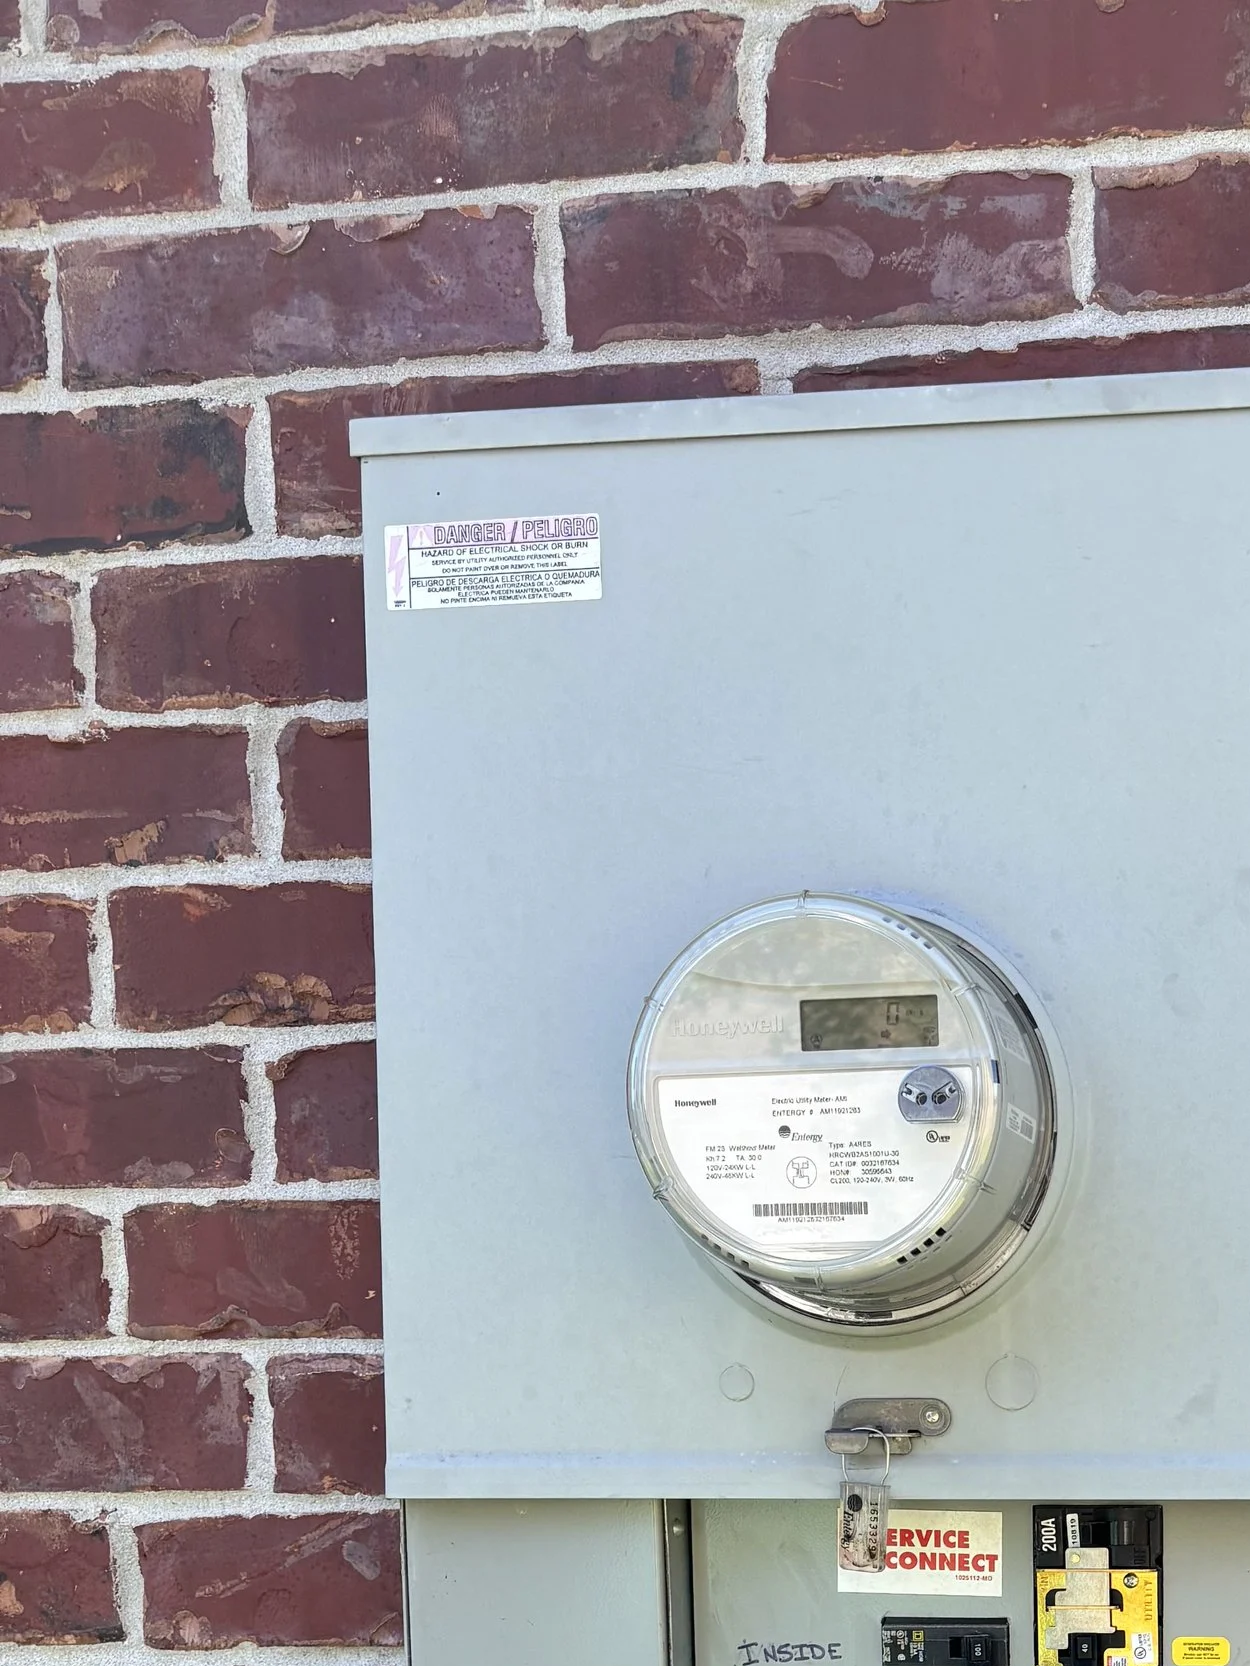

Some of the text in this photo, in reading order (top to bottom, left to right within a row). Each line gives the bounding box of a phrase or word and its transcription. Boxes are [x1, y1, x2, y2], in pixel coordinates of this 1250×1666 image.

[433, 522, 506, 545] DANGER
[522, 516, 598, 539] PELIGRO
[421, 541, 588, 557] HAZARD OF ELECTRICAL SHOCK OR BURN
[411, 579, 445, 588] PELIGRO
[446, 578, 457, 586] DE
[458, 576, 499, 585] DESCARGA
[501, 573, 542, 582] ELECTRICA
[552, 570, 600, 579] QUEMADURA
[671, 1015, 784, 1039] Honeywell
[674, 1098, 717, 1108] Honeywell
[771, 1097, 794, 1105] Electric
[772, 1109, 806, 1117] ENTERGY
[791, 1132, 823, 1142] Entergy
[885, 1528, 970, 1549] ERVICE
[1041, 1517, 1056, 1552] 200A
[884, 1551, 999, 1573] CONNECT
[1144, 1579, 1153, 1621] UTILITY
[737, 1642, 842, 1666] INSIDE
[1082, 1643, 1088, 1653] 40
